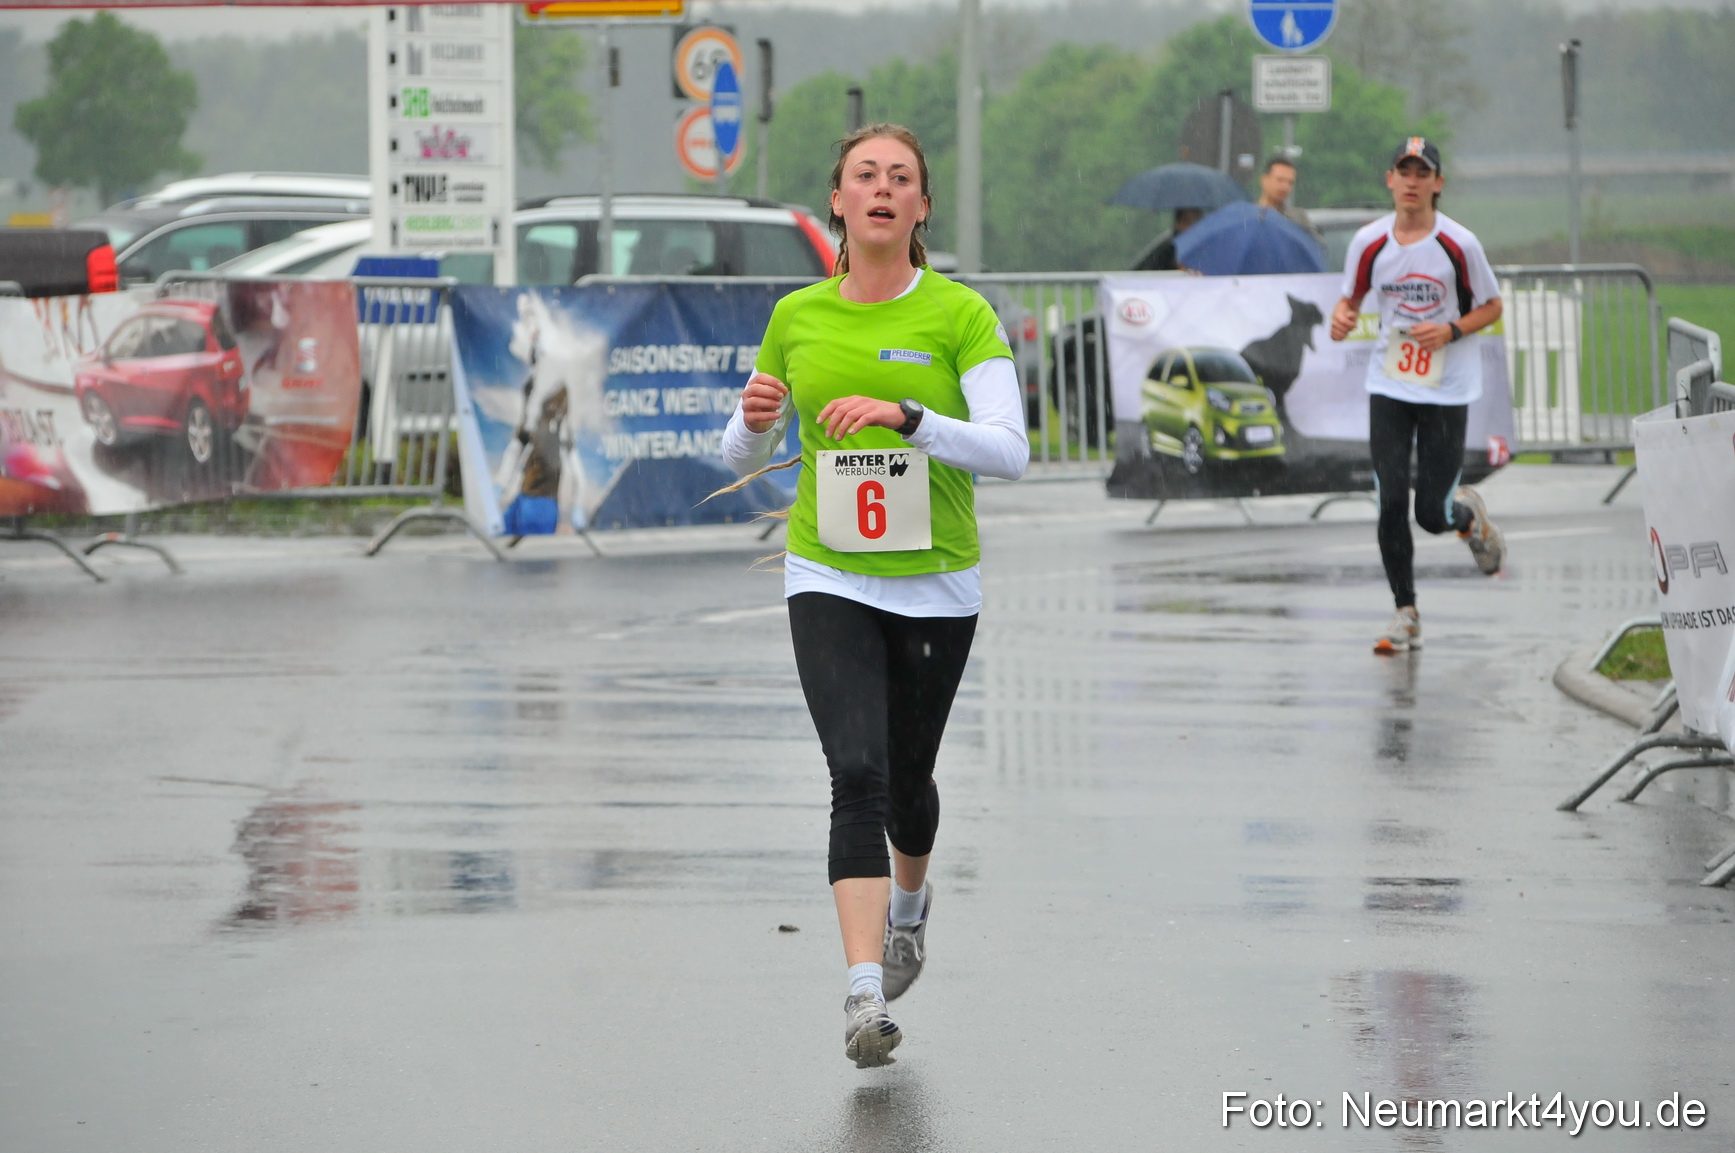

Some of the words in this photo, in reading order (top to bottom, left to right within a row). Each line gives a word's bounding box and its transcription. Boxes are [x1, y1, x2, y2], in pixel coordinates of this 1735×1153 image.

[608, 344, 734, 375] SAISONSTART
[892, 349, 931, 361] PFLEIDERER
[1398, 342, 1432, 376] 38
[604, 386, 660, 417] GANZ
[835, 454, 885, 467] MEYER
[835, 467, 886, 476] WERBUNG
[857, 480, 887, 540] 6
[1698, 609, 1717, 628] IST
